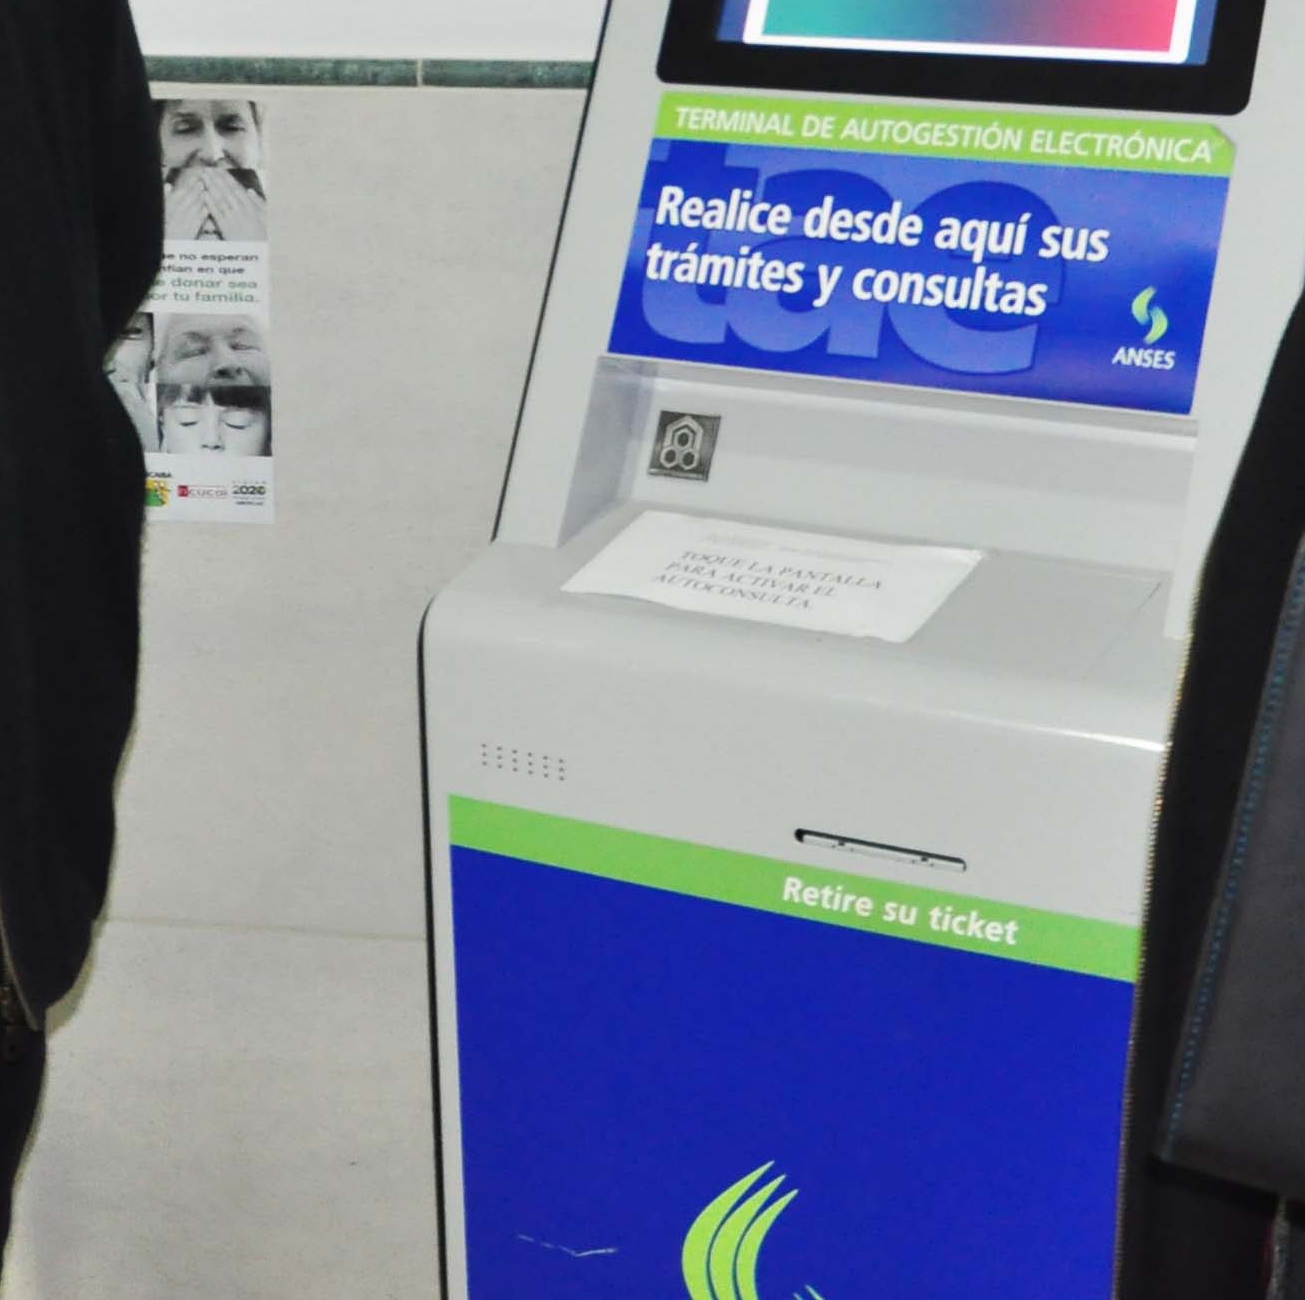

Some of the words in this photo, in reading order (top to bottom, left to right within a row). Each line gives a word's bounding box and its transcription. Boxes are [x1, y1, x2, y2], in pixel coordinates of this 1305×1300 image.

[674, 105, 794, 138] TERMINAL
[801, 113, 837, 139] DE
[840, 115, 1023, 153] AUTOGESTIÓN
[1030, 129, 1213, 164] ELECTRÓNICA
[655, 184, 793, 236] Realice
[803, 194, 924, 247] desde
[934, 211, 1032, 264] aquí
[1038, 223, 1110, 263] sus
[196, 265, 215, 274] en
[217, 265, 246, 275] que
[200, 252, 260, 263] esperan
[170, 276, 223, 289] donar
[227, 280, 259, 289] sea
[173, 291, 190, 302] tu
[646, 241, 806, 294] trámites
[812, 262, 843, 308] y
[851, 264, 1048, 317] consultas
[1111, 346, 1176, 370] ANSES
[664, 561, 717, 579] PARA
[722, 570, 811, 595] ACTIVAR
[812, 584, 838, 598] EL
[681, 549, 748, 570] TOQUE
[748, 560, 775, 575] LA
[777, 566, 883, 590] PANTALLA
[782, 875, 874, 918] Retire
[882, 901, 918, 926] su
[929, 904, 1020, 946] ticket
